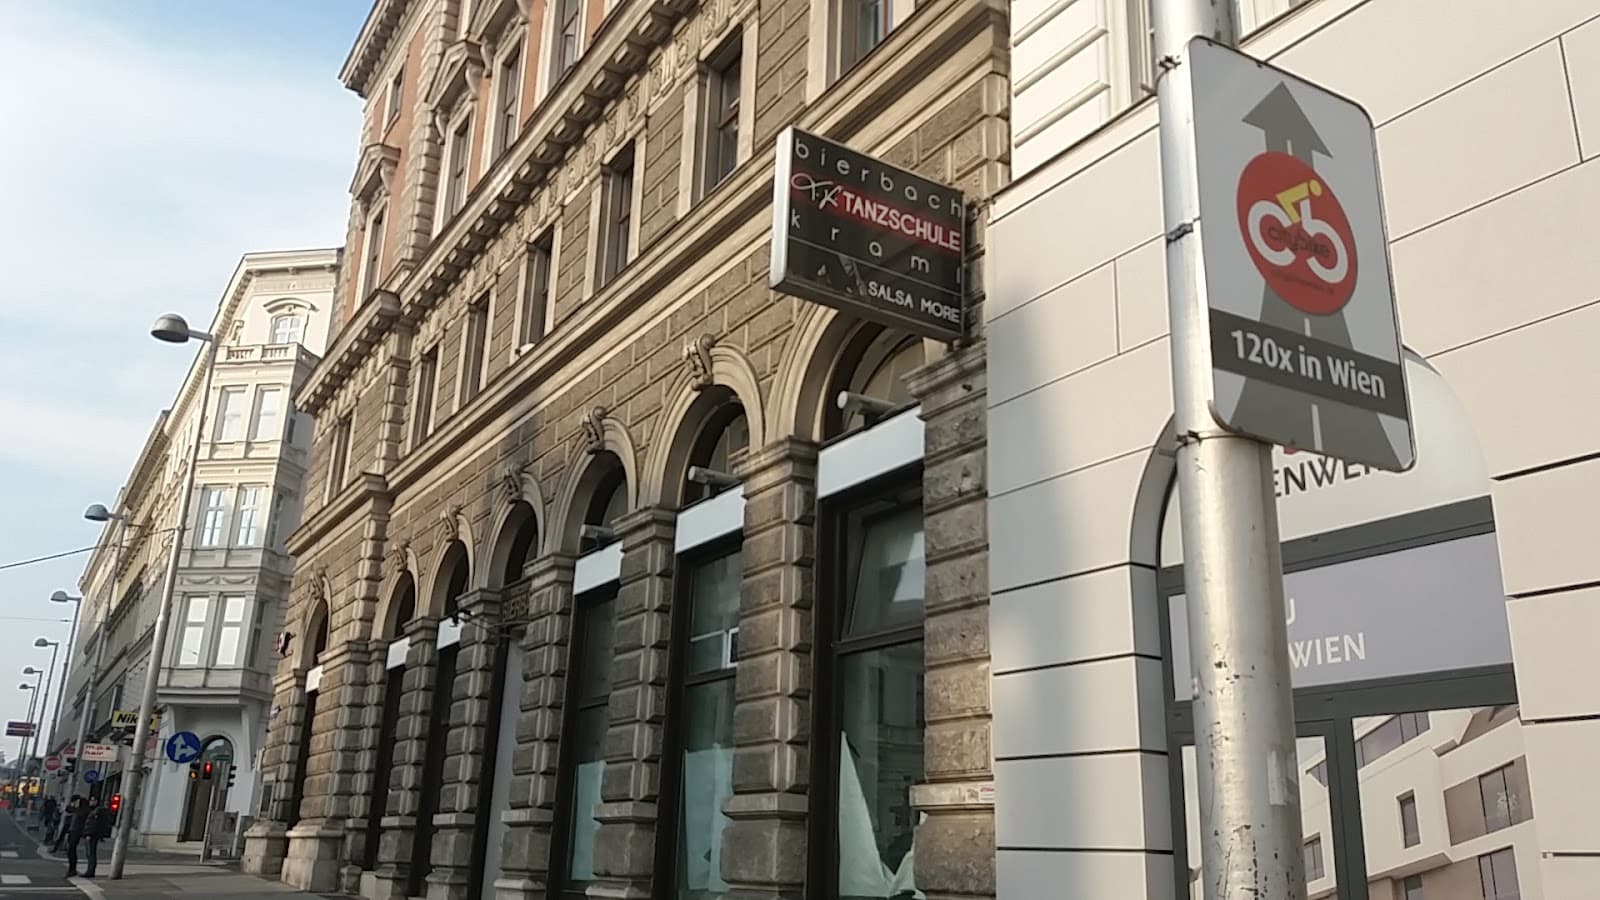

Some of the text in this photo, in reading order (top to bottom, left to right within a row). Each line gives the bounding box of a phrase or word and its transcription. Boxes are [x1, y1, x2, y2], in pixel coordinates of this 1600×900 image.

[795, 138, 961, 218] bierbach
[791, 208, 961, 284] kraml
[842, 191, 961, 251] TANZSCHULE
[867, 281, 960, 323] SALSA MORE
[1231, 329, 1386, 399] 120x in Wien
[1287, 631, 1366, 669] WIEN
